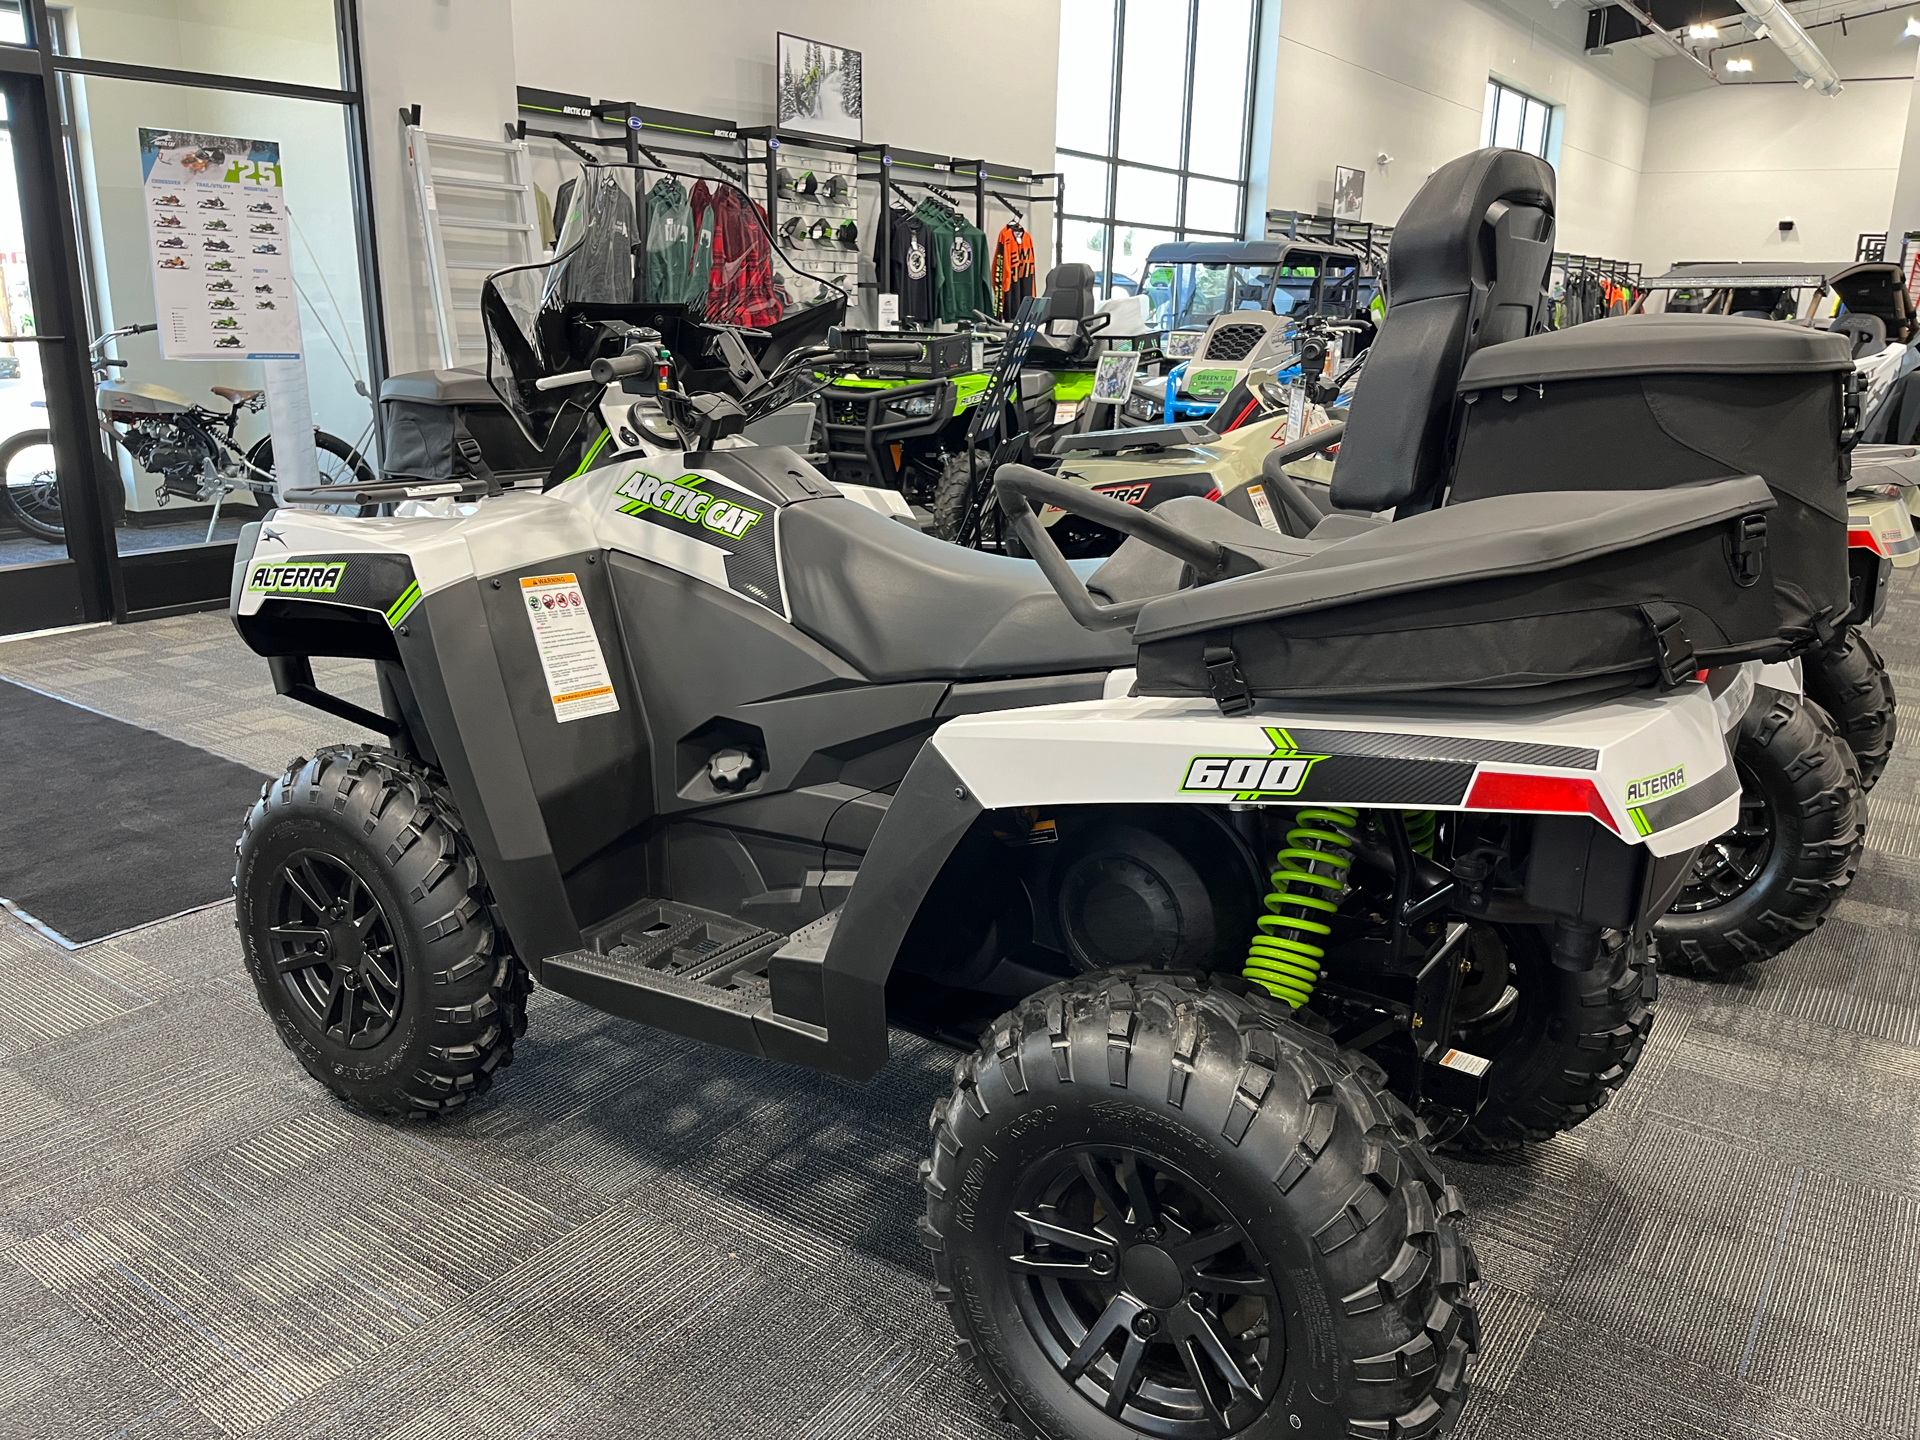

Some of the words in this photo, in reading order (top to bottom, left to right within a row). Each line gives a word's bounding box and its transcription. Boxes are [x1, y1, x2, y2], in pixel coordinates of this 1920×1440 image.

[563, 106, 579, 116] ARCTIC
[579, 108, 592, 117] CAT
[714, 129, 729, 138] ARCTIC
[728, 131, 738, 139] CAT
[616, 471, 712, 520] ARCTIC
[704, 502, 758, 536] CAT
[251, 567, 341, 588] ALTERRA
[538, 577, 566, 585] WARNING
[1184, 759, 1309, 790] 600
[1627, 767, 1685, 801] ALTERRA
